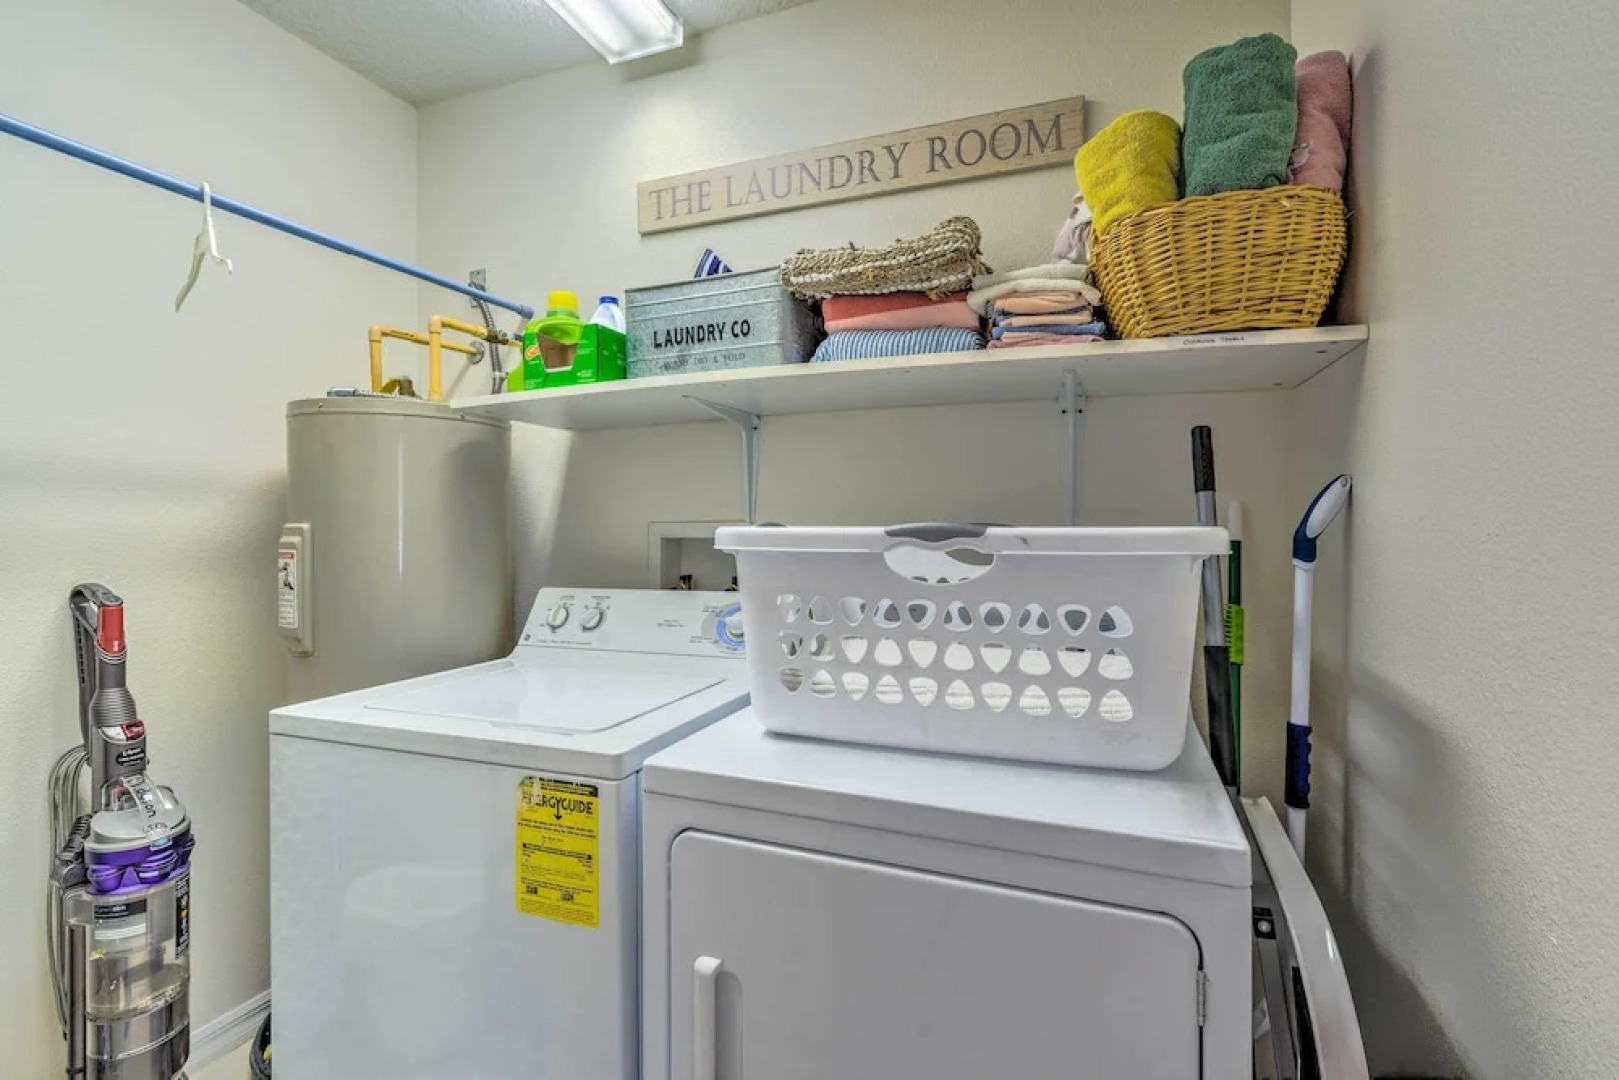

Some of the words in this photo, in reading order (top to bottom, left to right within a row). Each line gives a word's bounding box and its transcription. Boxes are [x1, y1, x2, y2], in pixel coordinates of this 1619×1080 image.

[649, 180, 712, 220] THE
[725, 141, 910, 208] LAUNDRY
[926, 113, 1064, 174] ROOM
[653, 322, 726, 349] LAUNDRY
[731, 319, 751, 338] CO
